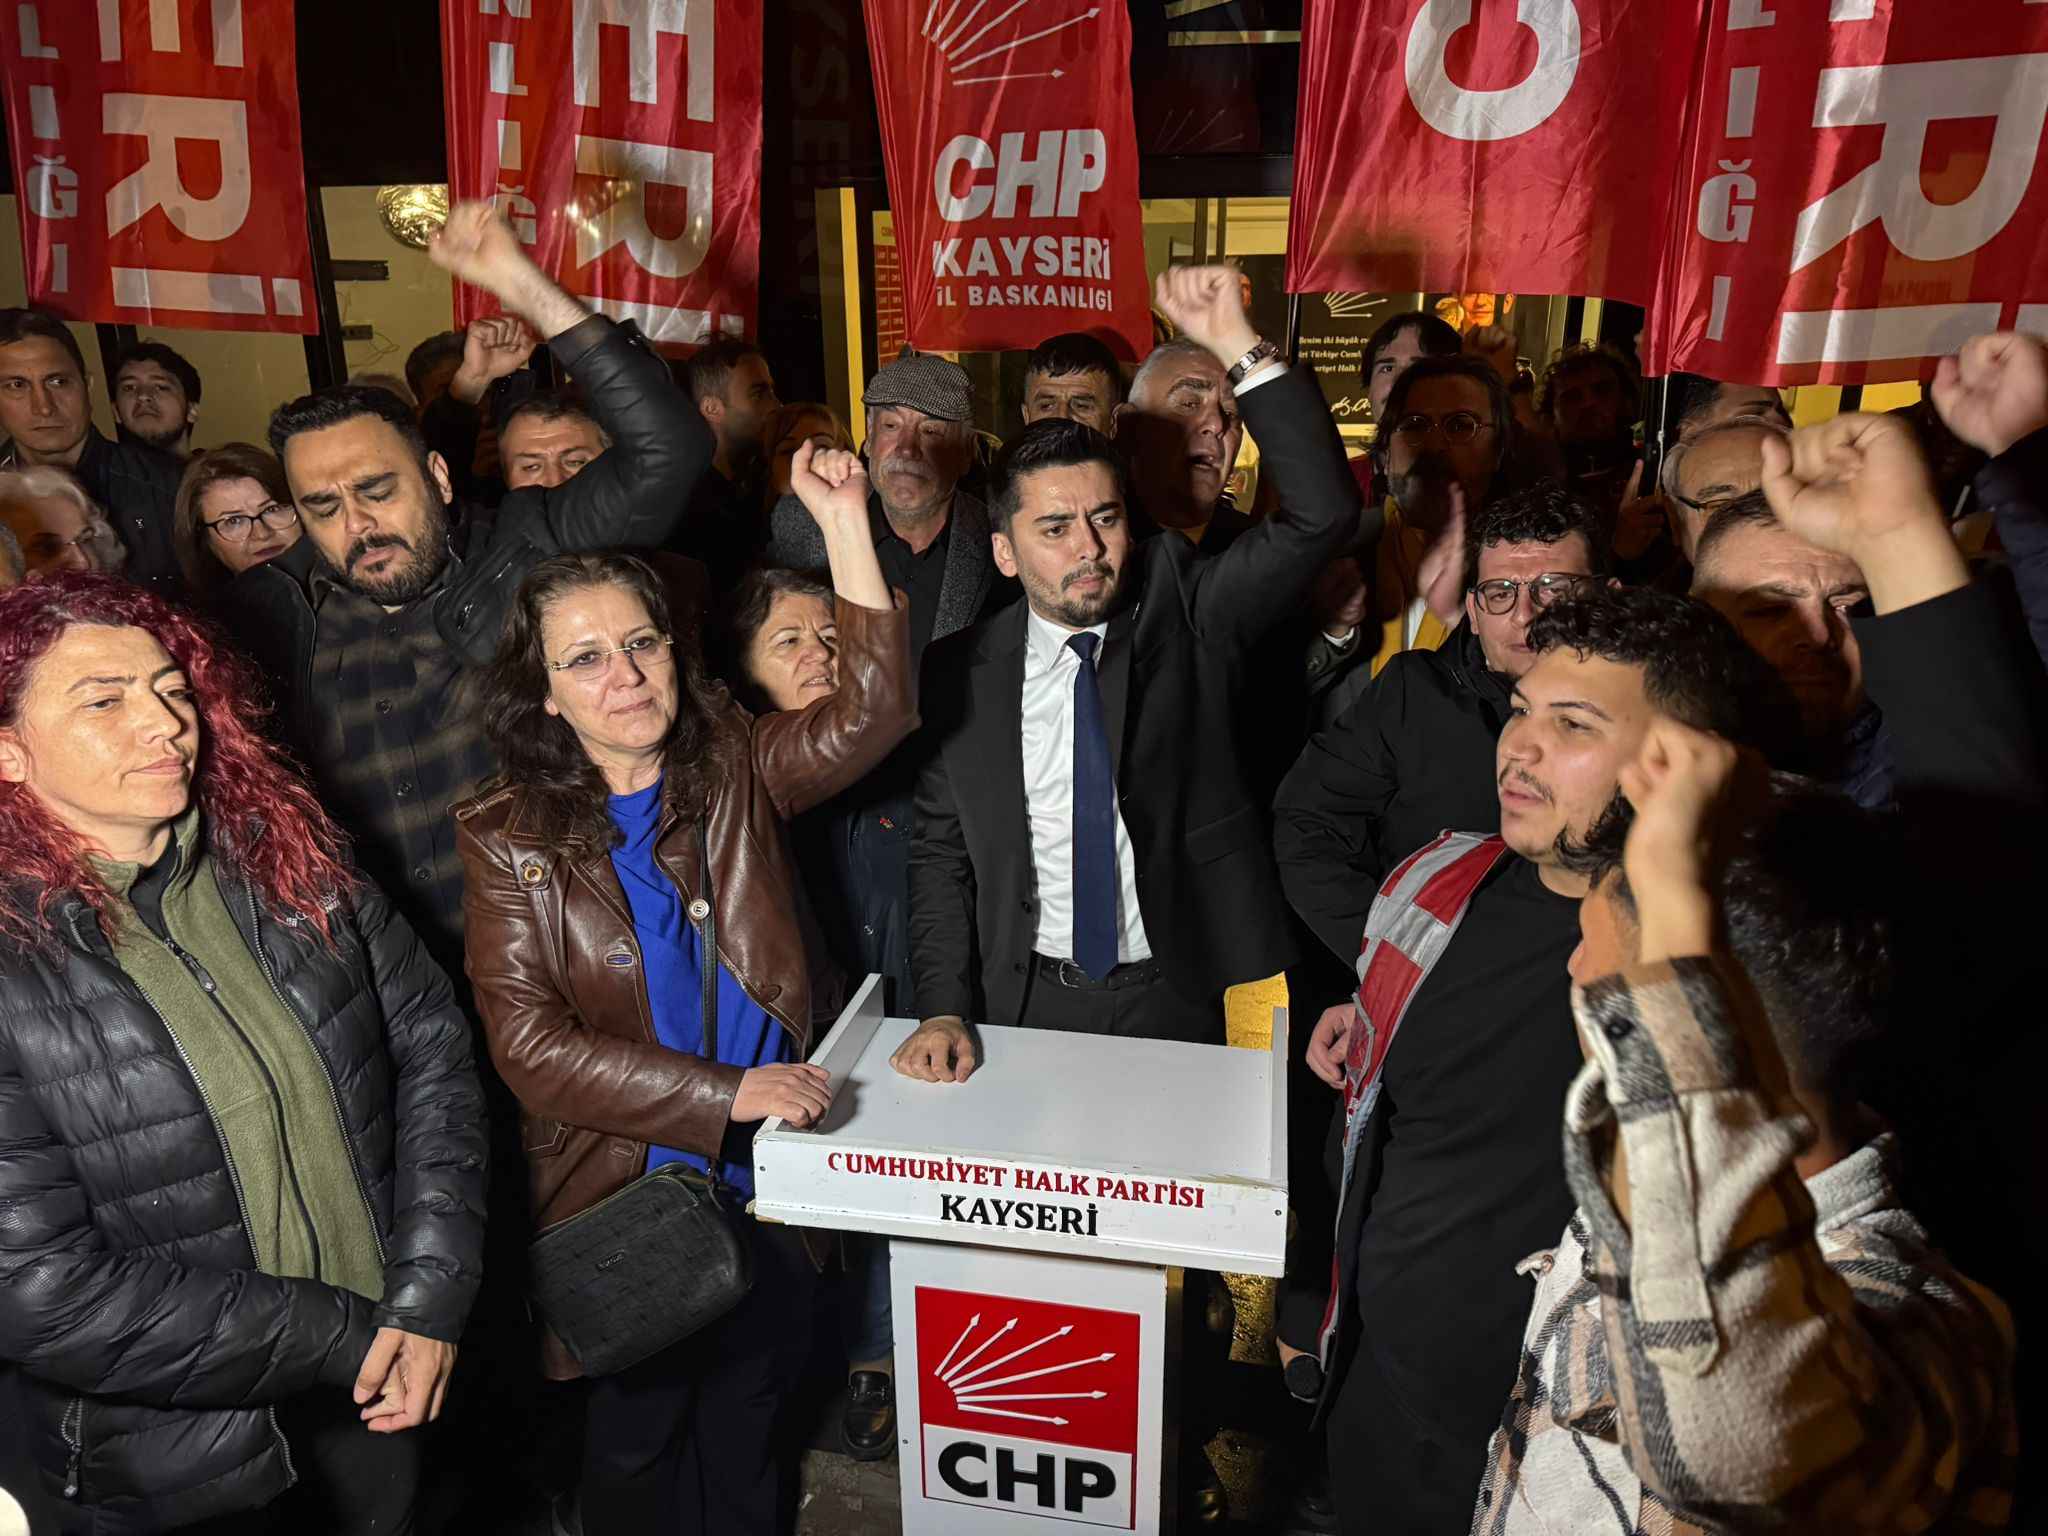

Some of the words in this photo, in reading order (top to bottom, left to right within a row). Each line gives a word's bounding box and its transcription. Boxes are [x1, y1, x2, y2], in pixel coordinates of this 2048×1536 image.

[934, 128, 1107, 223] CHP
[932, 235, 1111, 280] KAYSERİ
[1014, 1167, 1090, 1197] HALK
[940, 1193, 1099, 1237] KAYSERİ
[938, 1440, 1117, 1514] CHP
